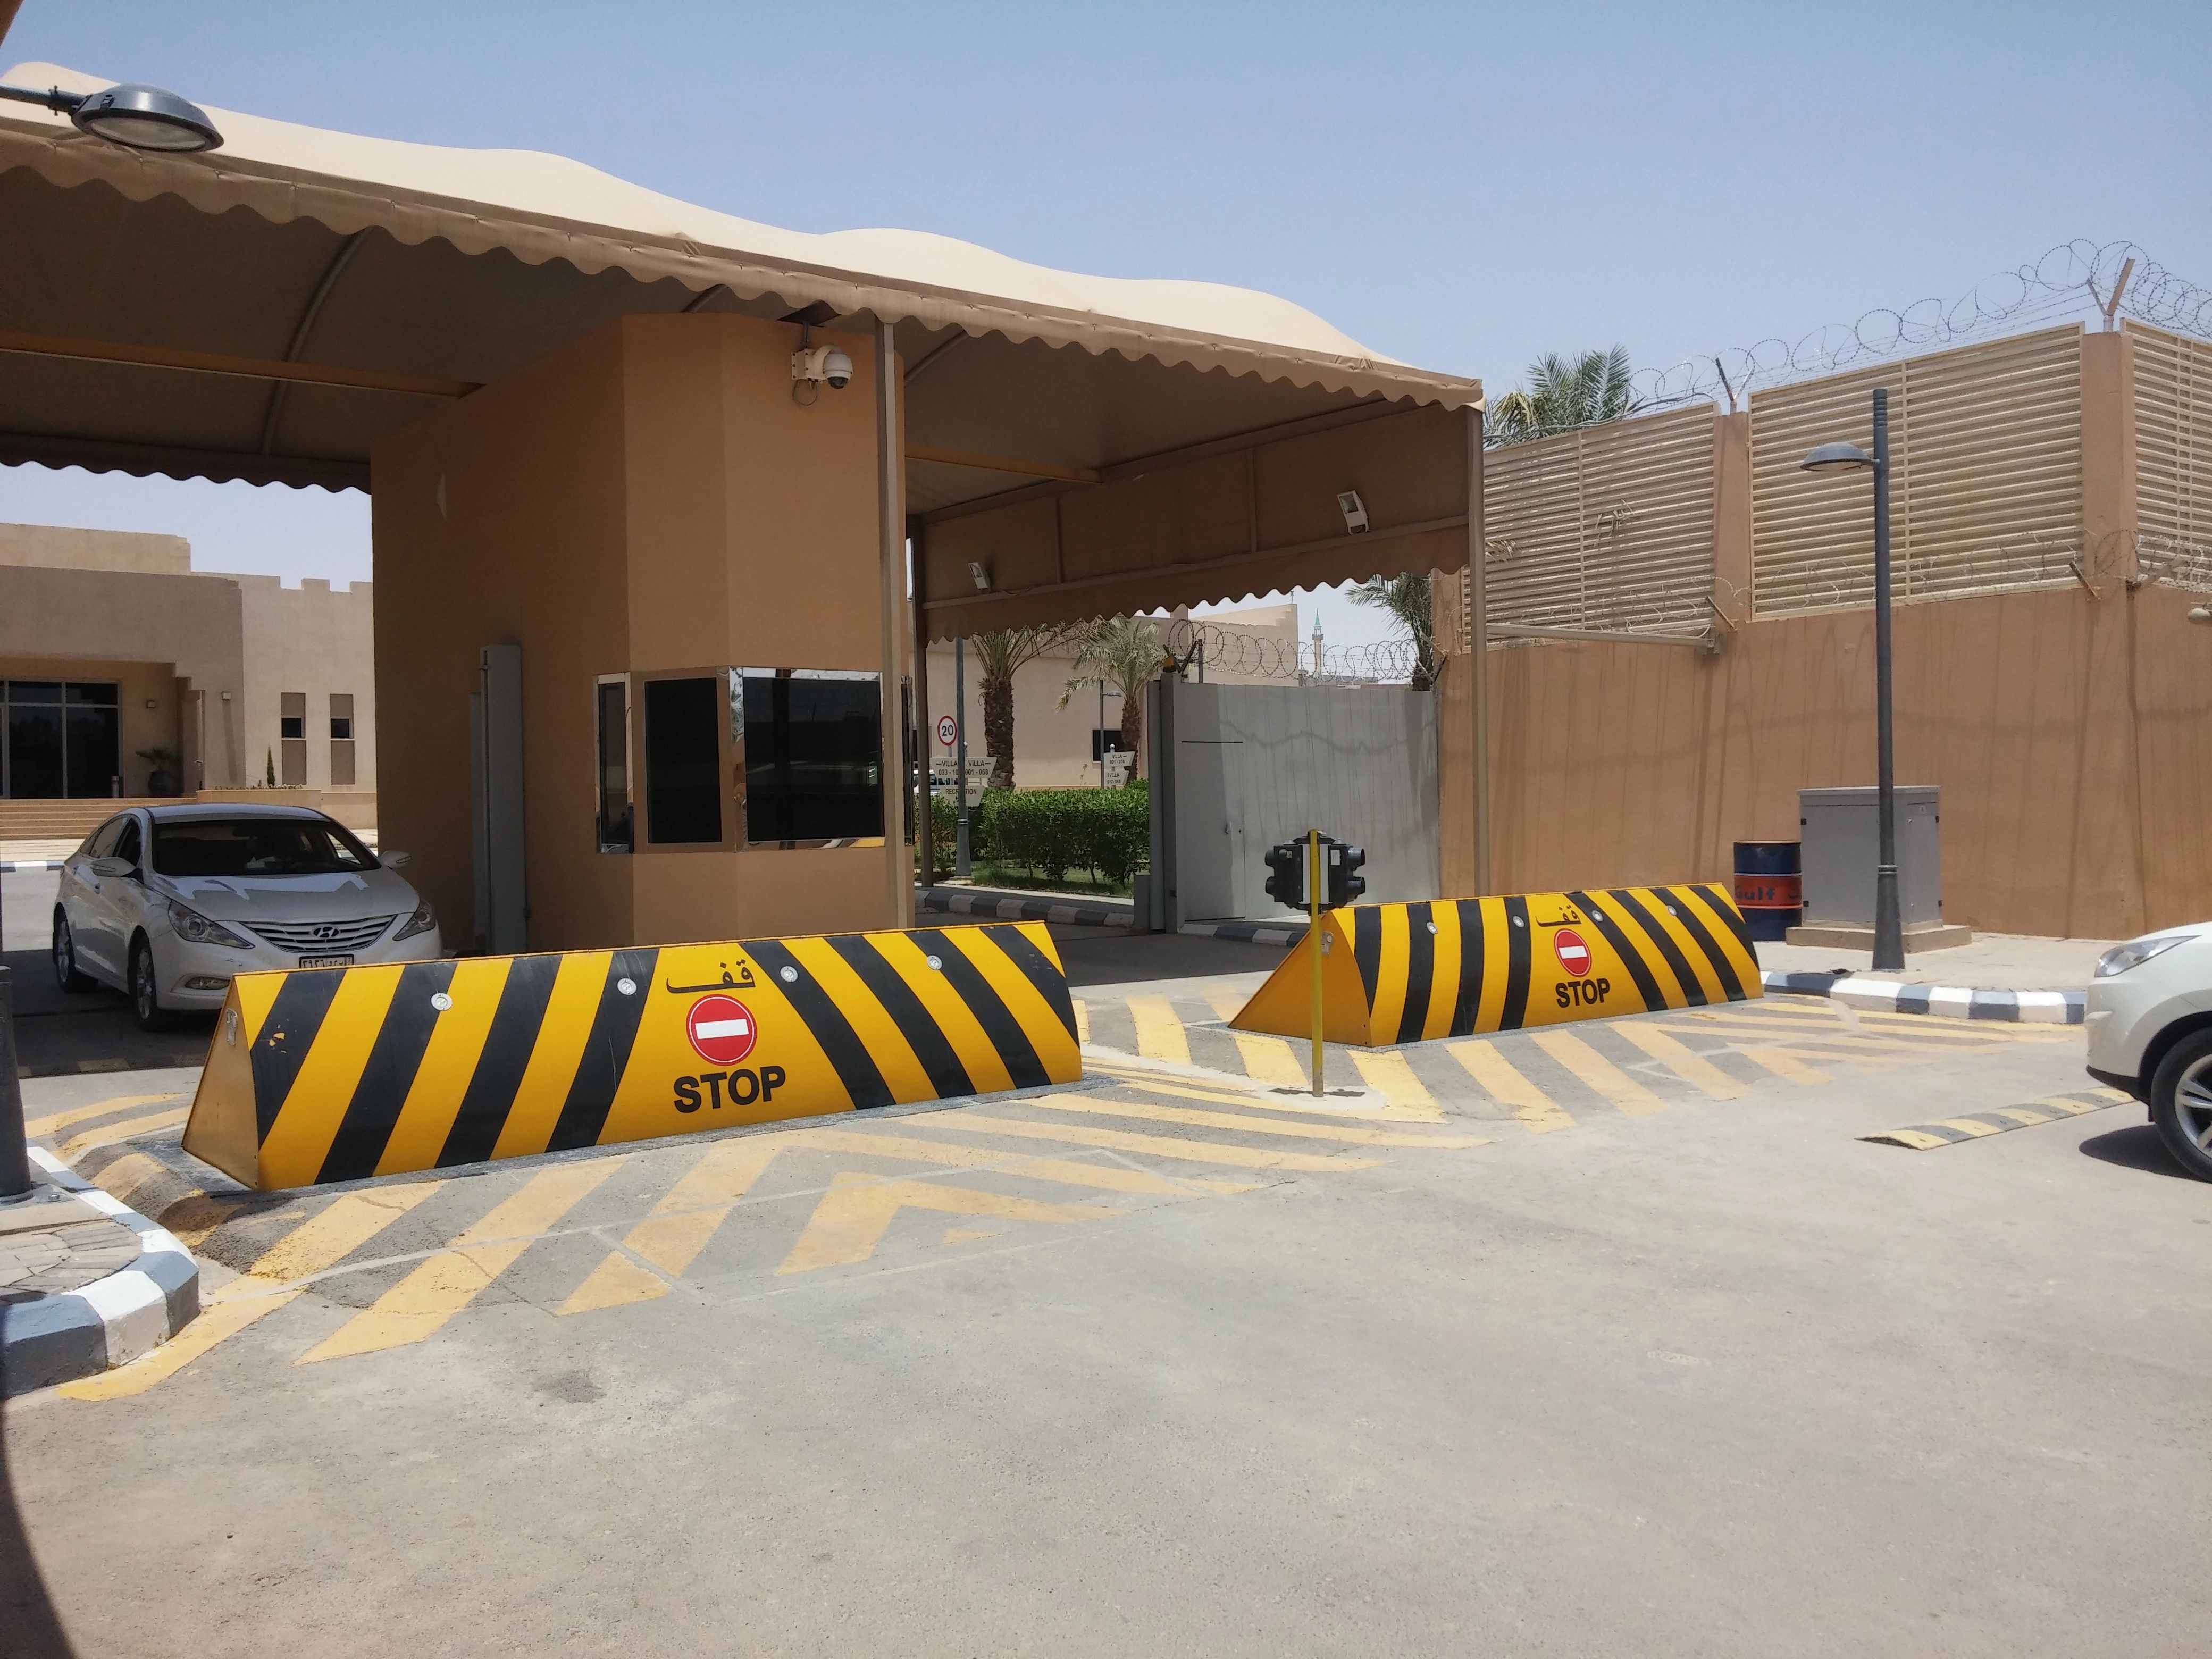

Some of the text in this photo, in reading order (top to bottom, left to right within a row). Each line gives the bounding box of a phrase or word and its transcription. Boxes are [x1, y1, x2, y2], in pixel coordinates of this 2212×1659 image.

[942, 725, 954, 736] 20
[1735, 885, 1775, 900] Gulf
[1535, 904, 1582, 927] قف
[666, 959, 756, 994] قف
[1555, 978, 1610, 1008] STOP
[674, 1065, 786, 1113] STOP
